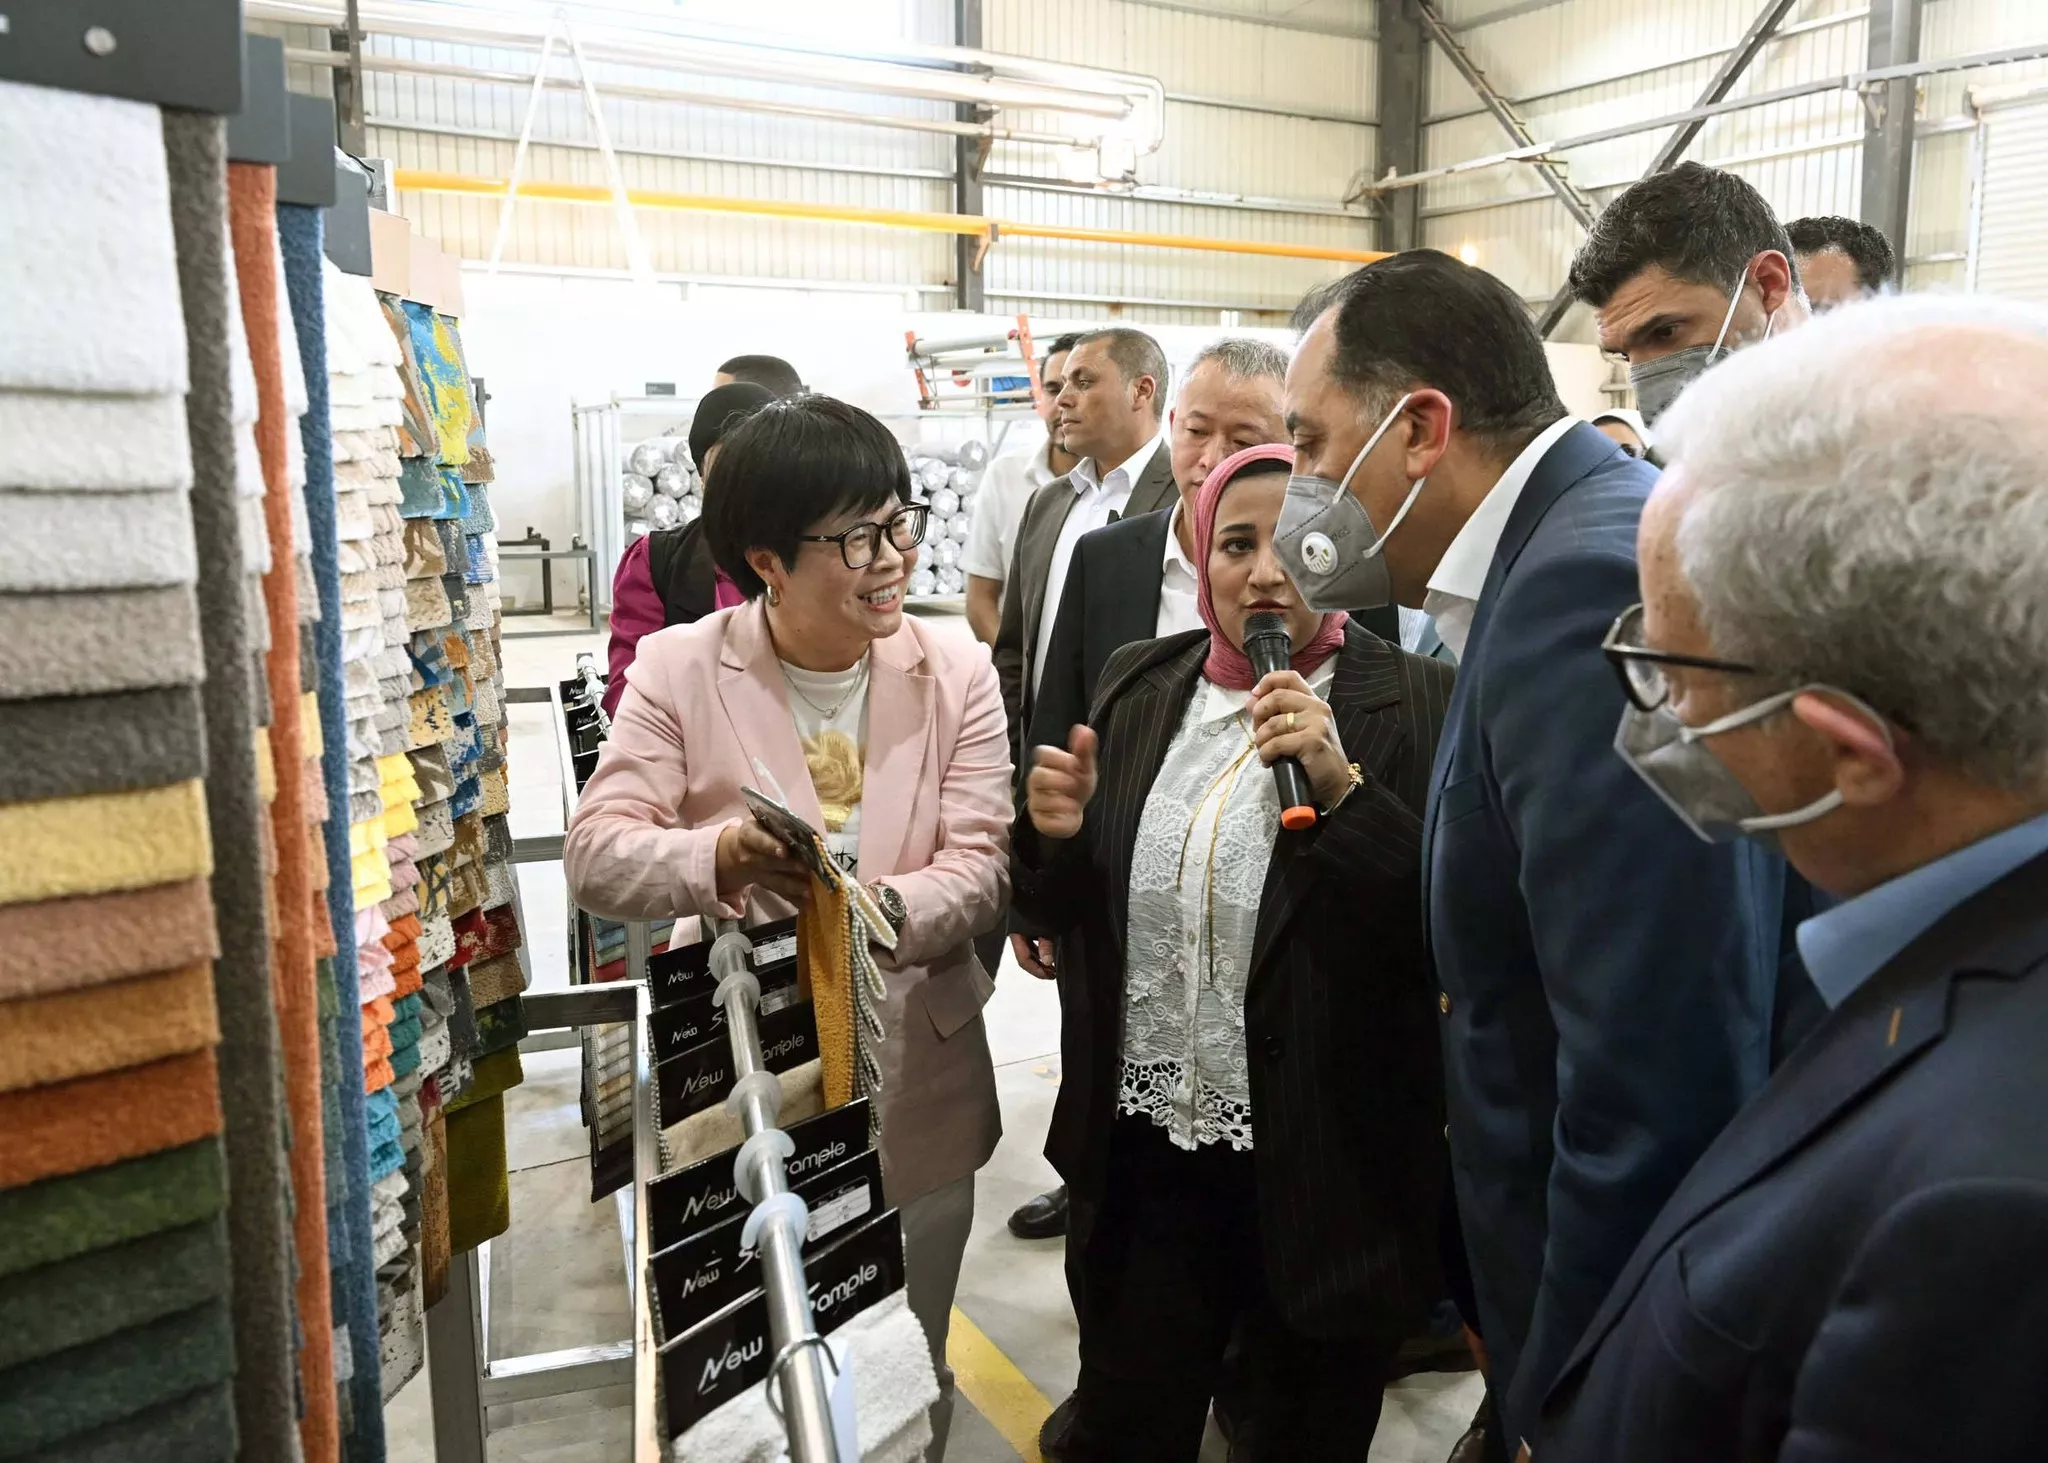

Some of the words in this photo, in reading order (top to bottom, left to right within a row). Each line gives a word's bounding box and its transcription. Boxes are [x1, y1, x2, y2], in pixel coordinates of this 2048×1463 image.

[667, 970, 694, 986] New
[670, 1027, 698, 1045] New
[681, 1068, 724, 1099] New
[761, 1034, 805, 1063] ample
[681, 1180, 738, 1224] New
[784, 1141, 846, 1176] ample
[681, 1265, 720, 1299] New
[697, 1335, 764, 1393] New
